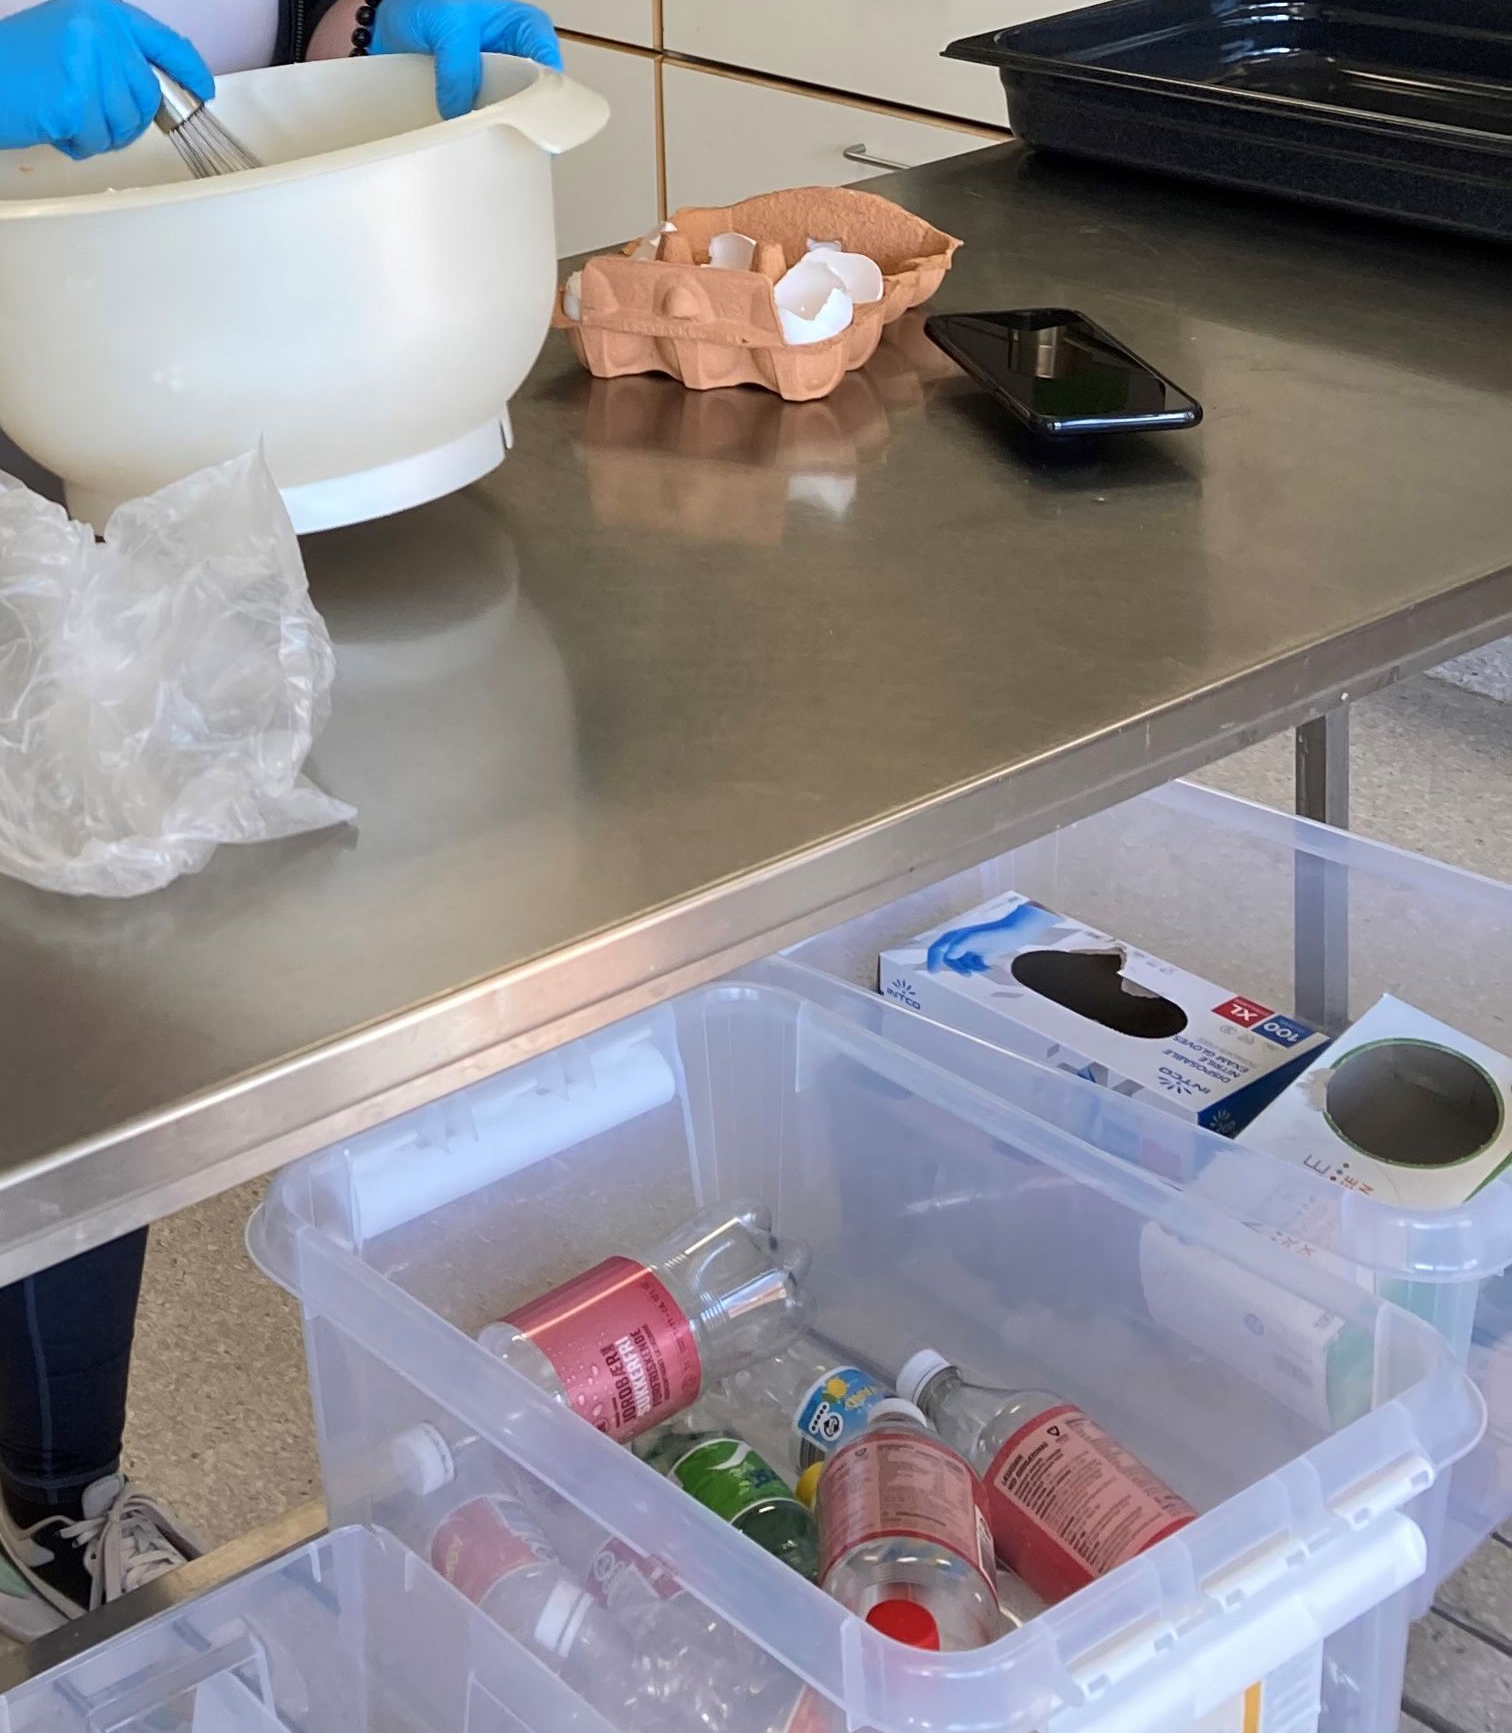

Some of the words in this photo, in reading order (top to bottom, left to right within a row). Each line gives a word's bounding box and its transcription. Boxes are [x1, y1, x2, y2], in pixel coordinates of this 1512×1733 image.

[886, 987, 921, 1010] INTCO
[1230, 1003, 1259, 1022] XL
[1263, 1021, 1300, 1043] 100
[1172, 1034, 1212, 1057] GLOVES
[1161, 1048, 1232, 1084] DISPOSABLE
[1198, 1056, 1242, 1079] NITRILE
[1215, 1051, 1250, 1074] EXAM
[1158, 1066, 1212, 1095] INTCO
[614, 1335, 651, 1417] SUKKERFRI
